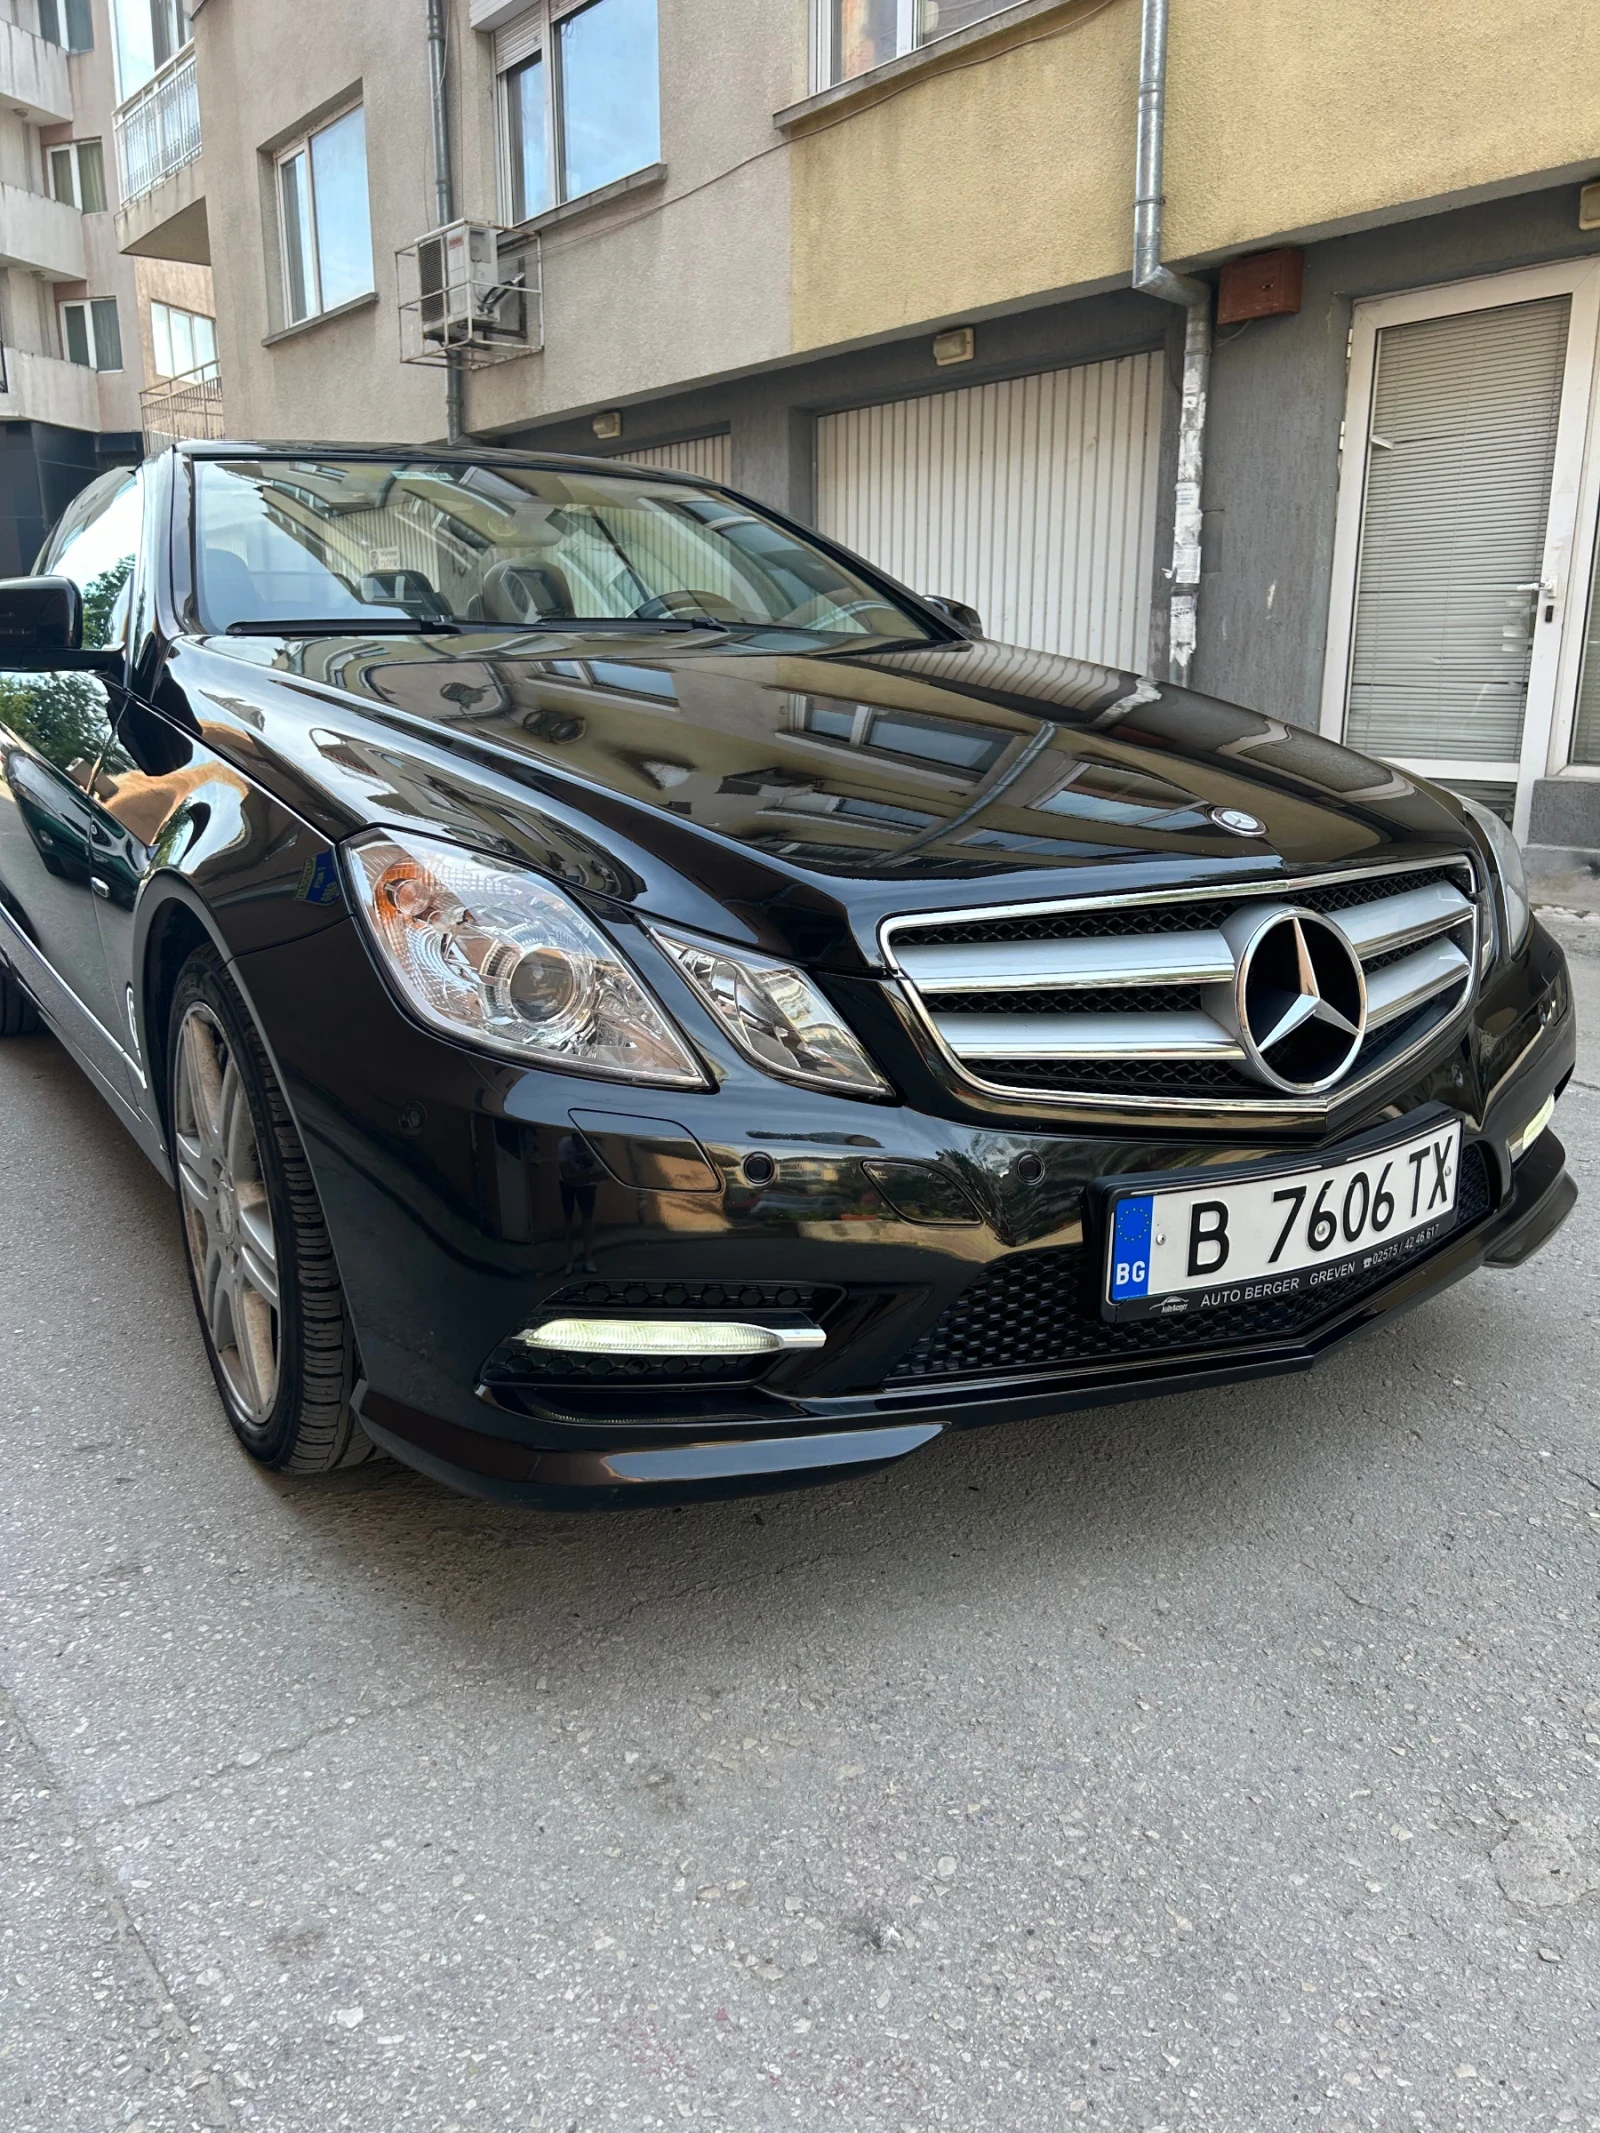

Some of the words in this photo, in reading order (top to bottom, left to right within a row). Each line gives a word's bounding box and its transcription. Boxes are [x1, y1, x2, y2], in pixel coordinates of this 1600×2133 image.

[1187, 1200, 1230, 1278] B
[1268, 1161, 1396, 1264] 7606
[1408, 1134, 1454, 1218] TX
[1115, 1259, 1147, 1286] BG
[1200, 1289, 1241, 1308] AUTO
[1244, 1277, 1300, 1300] BERGER
[1309, 1261, 1356, 1286] GREVEN
[1373, 1244, 1398, 1264] 02575
